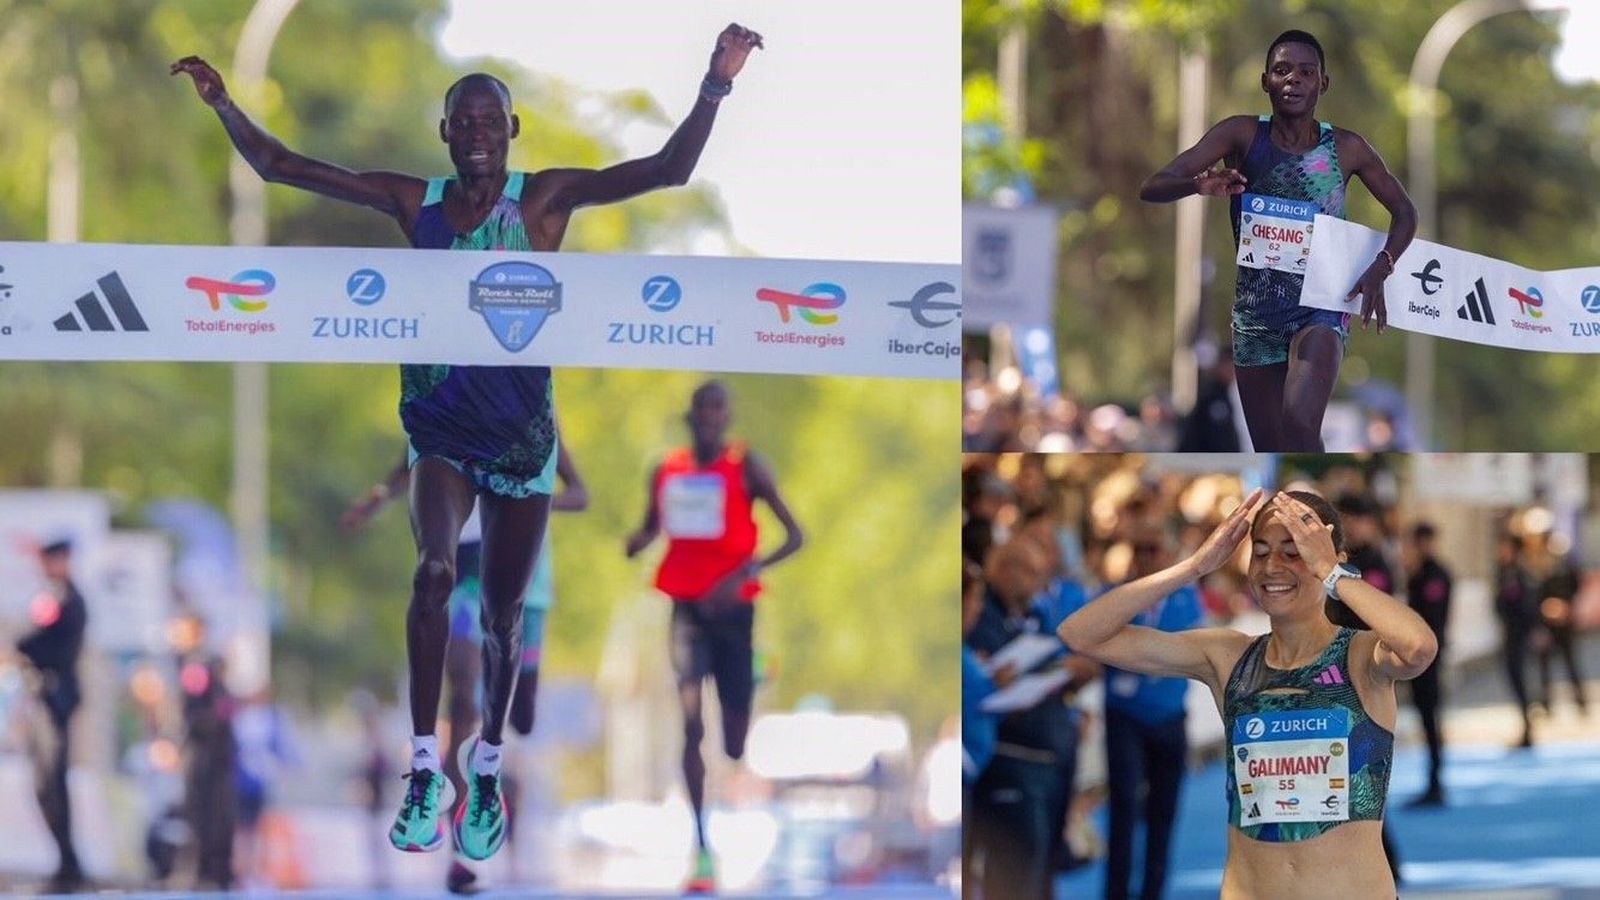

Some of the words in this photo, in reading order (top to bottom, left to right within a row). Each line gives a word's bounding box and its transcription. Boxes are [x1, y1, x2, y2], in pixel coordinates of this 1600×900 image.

[1268, 202, 1307, 216] ZURICH
[1252, 223, 1304, 244] CHESANG
[1269, 242, 1280, 251] 62
[1409, 300, 1440, 320] iberCaja
[185, 319, 275, 334] TotalEnergies
[312, 317, 419, 338] ZURICH
[608, 322, 714, 346] ZURICH
[755, 331, 846, 348] TotalEnergies
[888, 339, 961, 359] iberCaja
[1271, 718, 1328, 733] ZURICH
[1248, 755, 1331, 778] GALIMANY
[1278, 779, 1296, 791] 55
